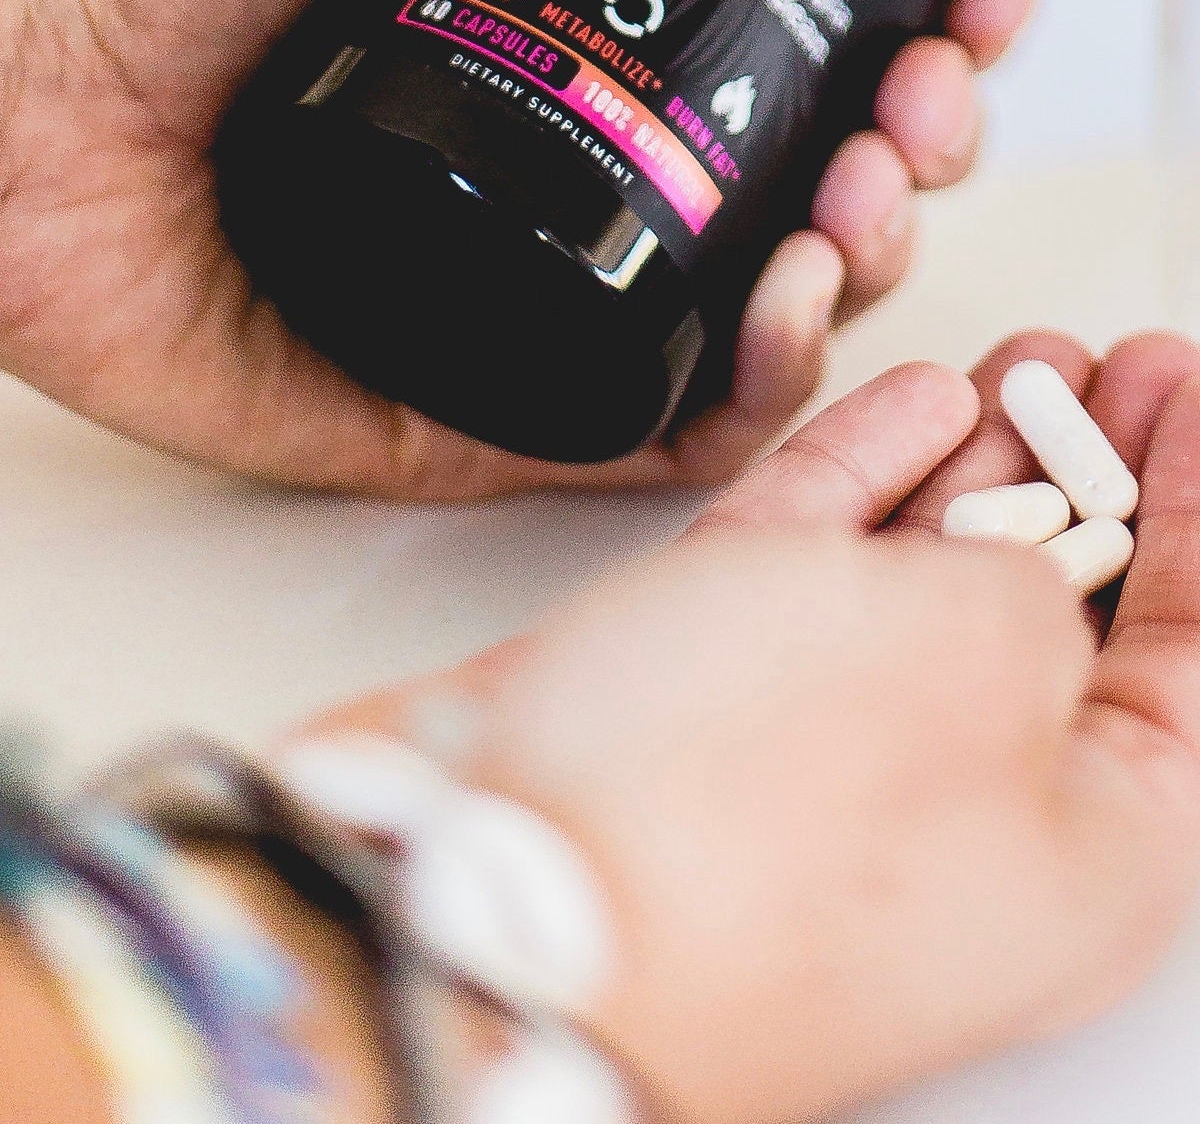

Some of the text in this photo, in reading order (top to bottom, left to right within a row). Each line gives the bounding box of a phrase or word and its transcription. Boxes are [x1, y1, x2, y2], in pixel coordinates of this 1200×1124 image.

[452, 8, 560, 74] CAPSULES
[450, 53, 636, 187] DIETARY SUPPLEMENT
[583, 80, 636, 133] 100%
[665, 95, 714, 152] BURN
